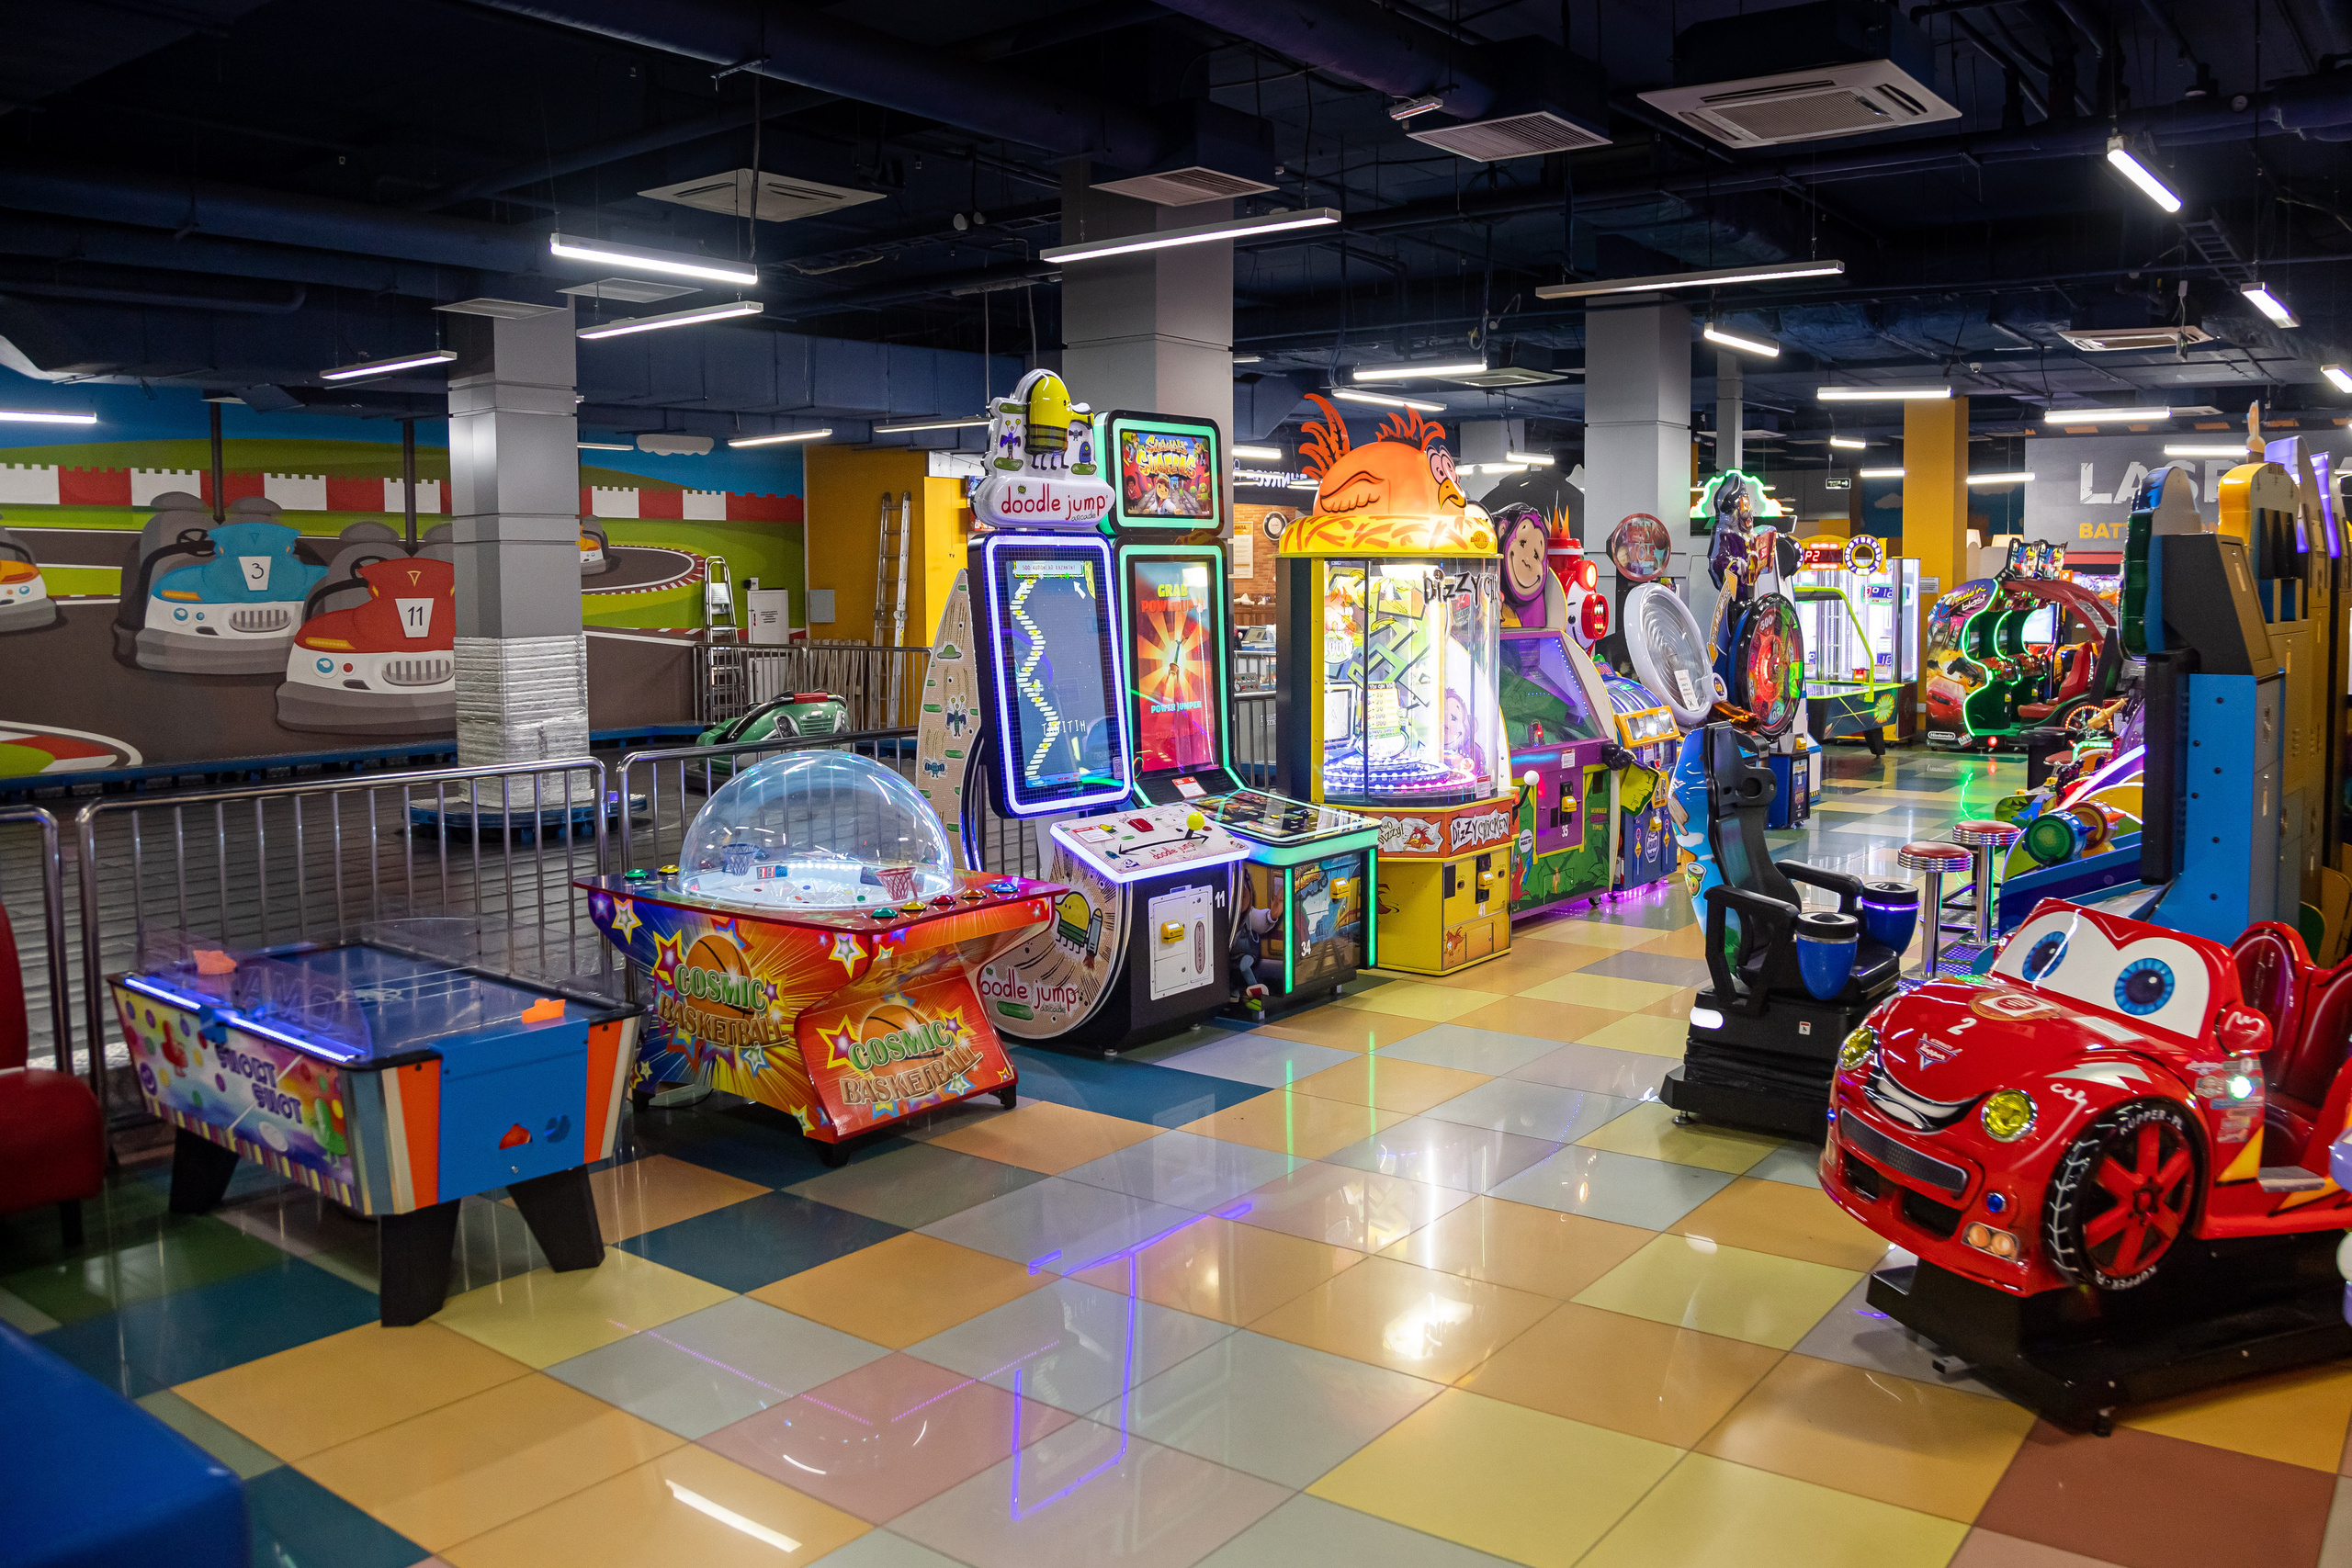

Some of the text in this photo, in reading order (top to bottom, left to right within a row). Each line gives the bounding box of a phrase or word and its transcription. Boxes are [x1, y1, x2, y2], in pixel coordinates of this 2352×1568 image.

[2080, 459, 2239, 503] LASE
[1001, 483, 1105, 520] doodle jump
[1804, 550, 1820, 562] P2
[251, 561, 264, 581] 3
[1158, 584, 1188, 598] GRAB
[407, 605, 425, 626] 11
[1150, 701, 1202, 714] POWER JUMPER
[1562, 825, 1568, 838] 35
[1215, 890, 1225, 908] 11
[1301, 939, 1311, 957] 34
[673, 964, 767, 1012] COSMIC
[980, 968, 1076, 1011] oodle jump
[658, 991, 792, 1050] BASKETBALL
[1946, 1017, 1976, 1035] 2
[847, 1020, 956, 1072] COSMIC
[840, 1045, 984, 1106] BASKETBALL
[252, 1083, 302, 1124] SHOT
